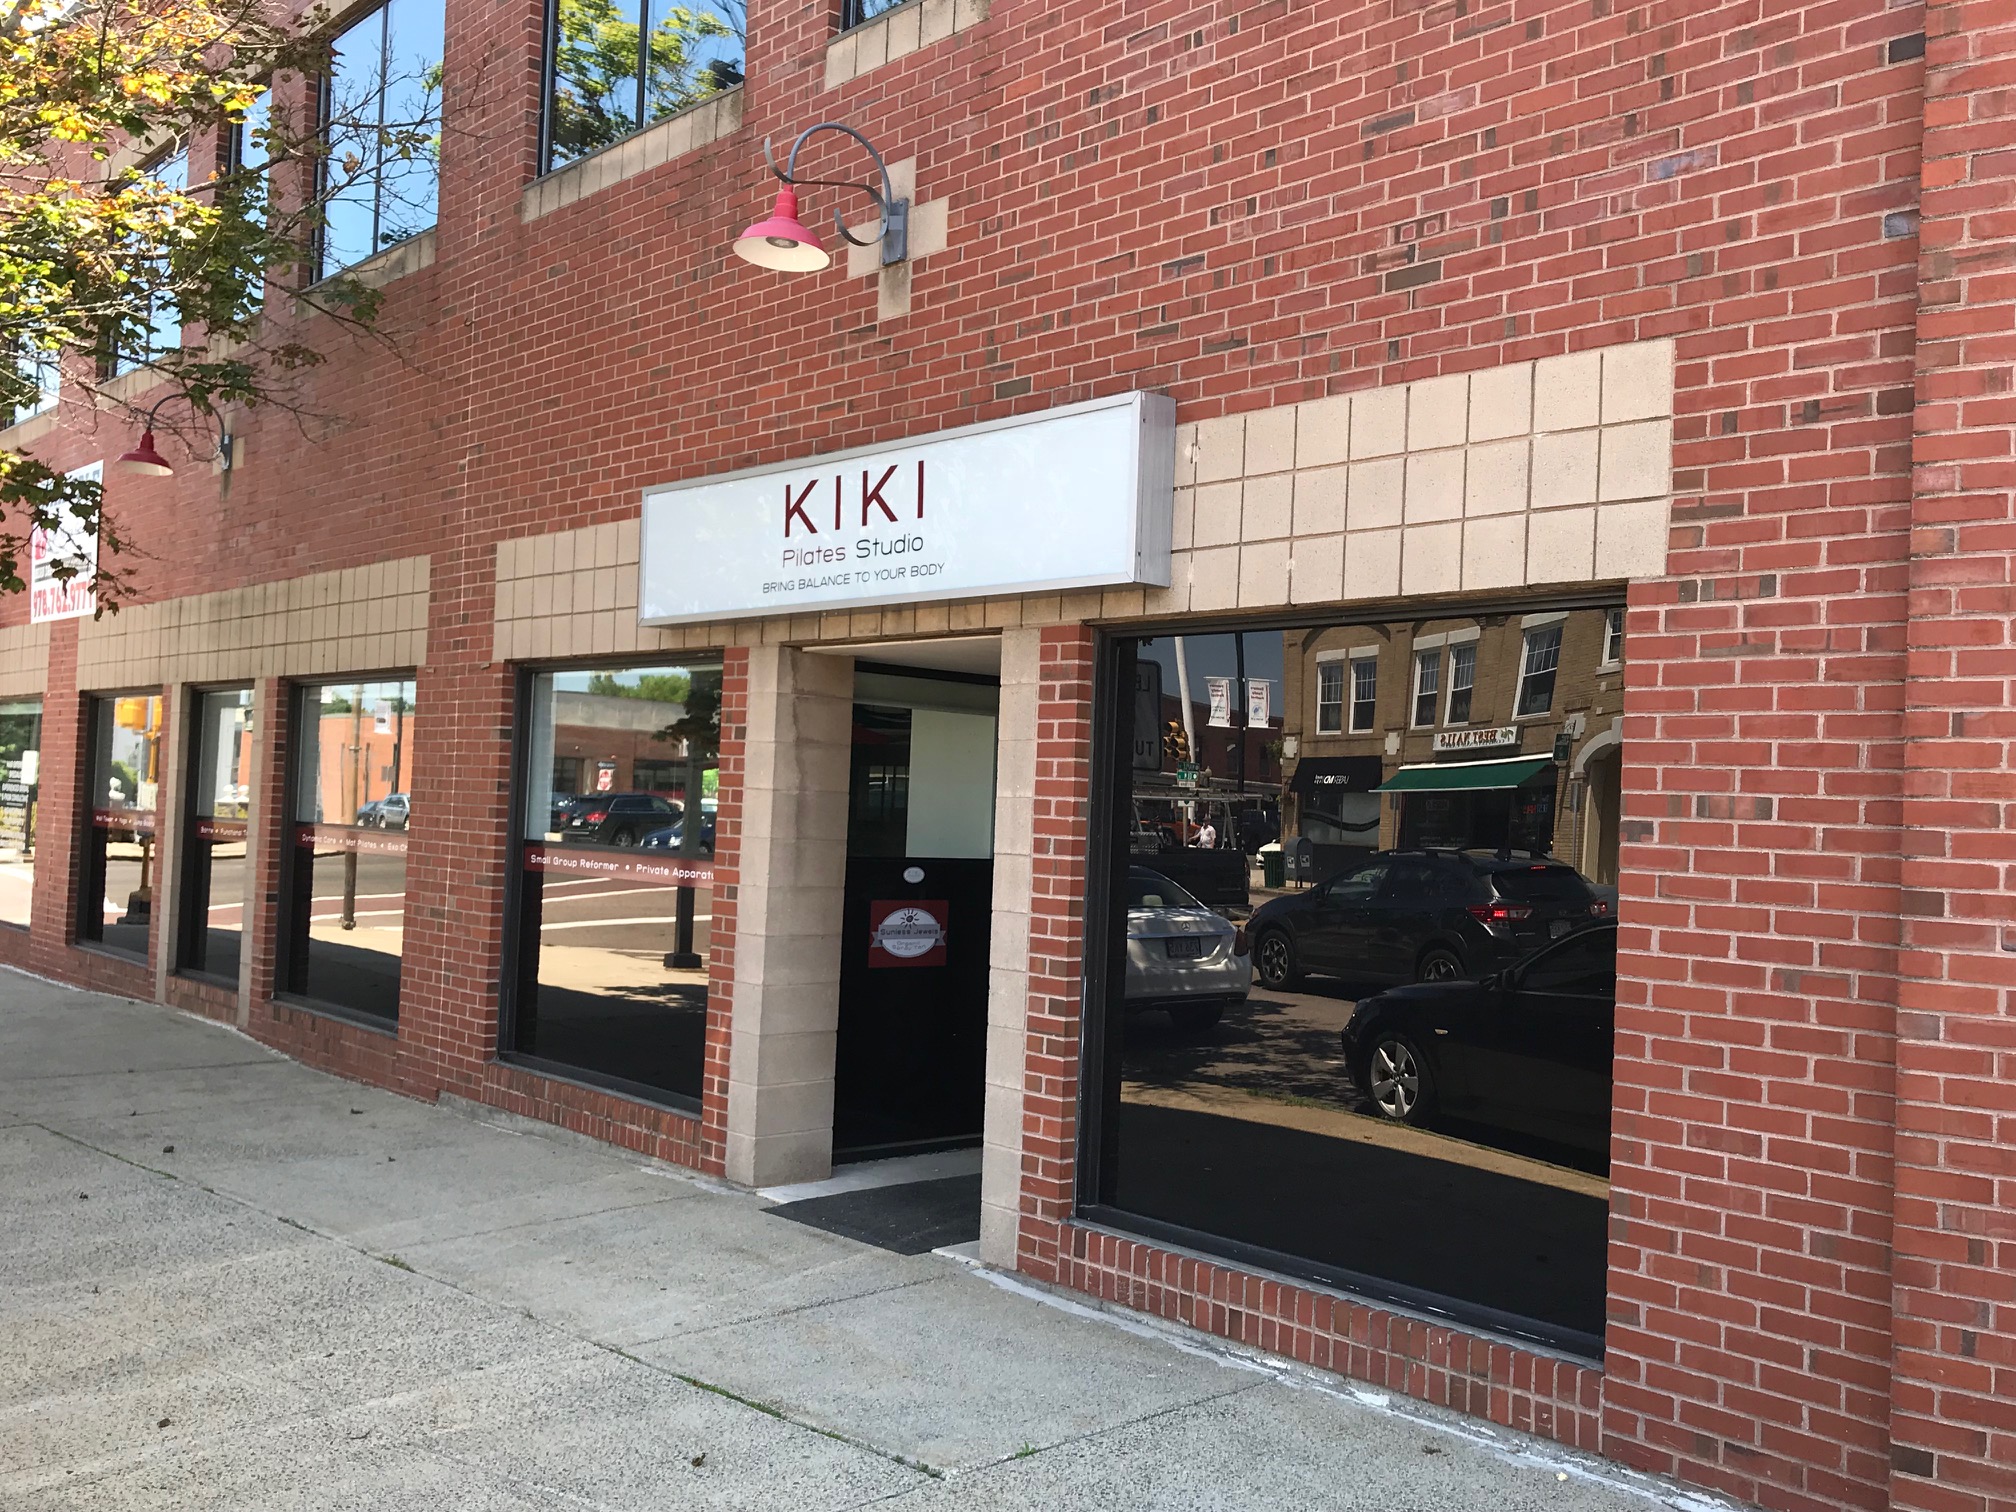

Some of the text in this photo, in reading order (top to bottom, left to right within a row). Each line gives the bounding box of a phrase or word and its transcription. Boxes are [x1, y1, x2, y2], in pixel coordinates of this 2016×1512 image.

[784, 460, 925, 538] KIKI
[782, 533, 924, 568] Pilates Studio
[762, 562, 945, 594] BRING BALANCE TO YOUR BODY
[530, 854, 550, 864] Small
[552, 856, 578, 868] Group
[580, 858, 619, 871] Reformer
[636, 864, 669, 876] Private
[880, 928, 910, 936] Sunless
